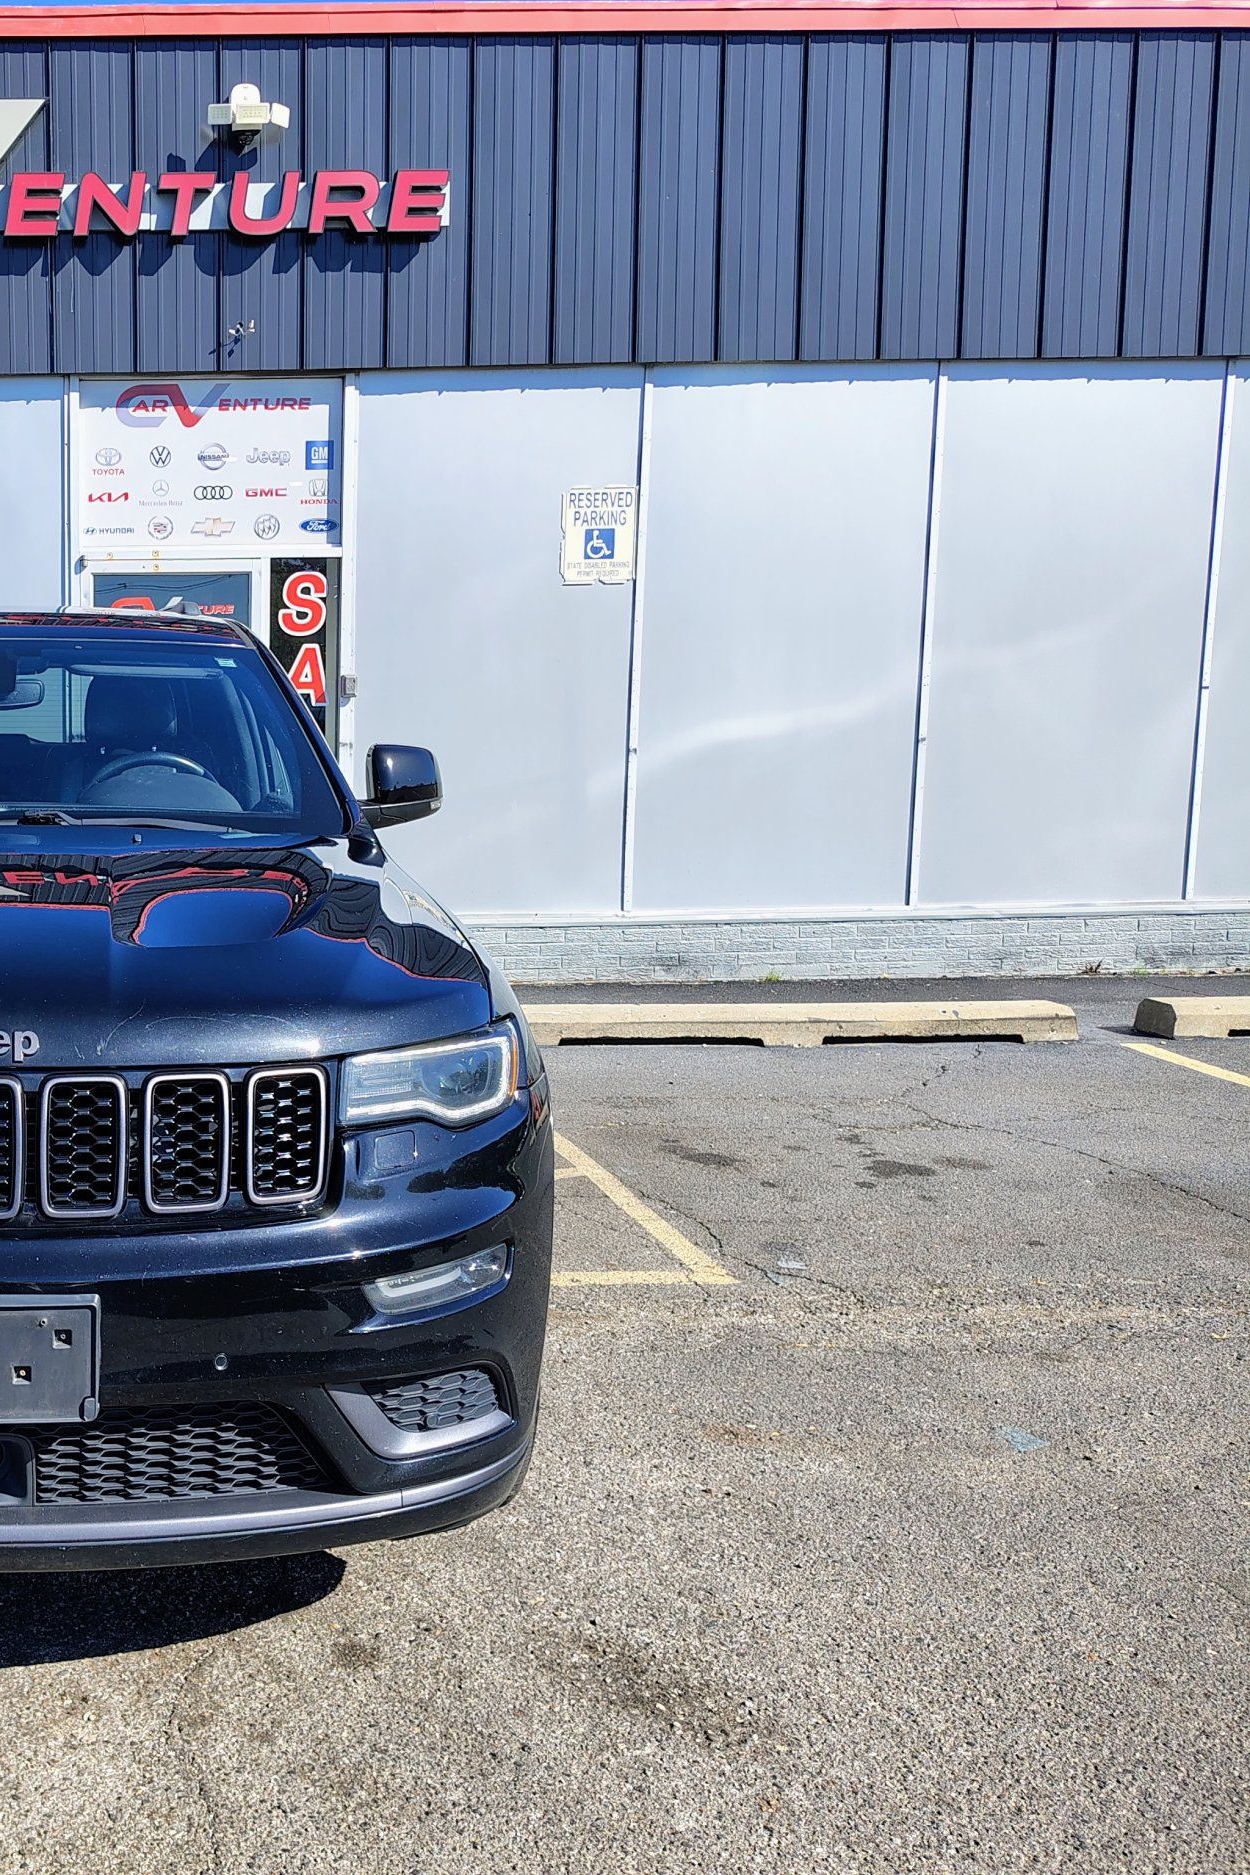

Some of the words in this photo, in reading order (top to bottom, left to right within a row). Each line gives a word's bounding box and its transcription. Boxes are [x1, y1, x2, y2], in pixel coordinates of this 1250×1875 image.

[246, 447, 291, 466] Jeep
[311, 446, 329, 460] GM
[92, 468, 125, 476] TOYOTA
[88, 492, 129, 502] KIA
[245, 488, 287, 497] GMC
[568, 491, 633, 508] RESERVED
[573, 510, 627, 527] PARKING
[306, 519, 332, 532] Ford
[567, 562, 582, 570] STATE
